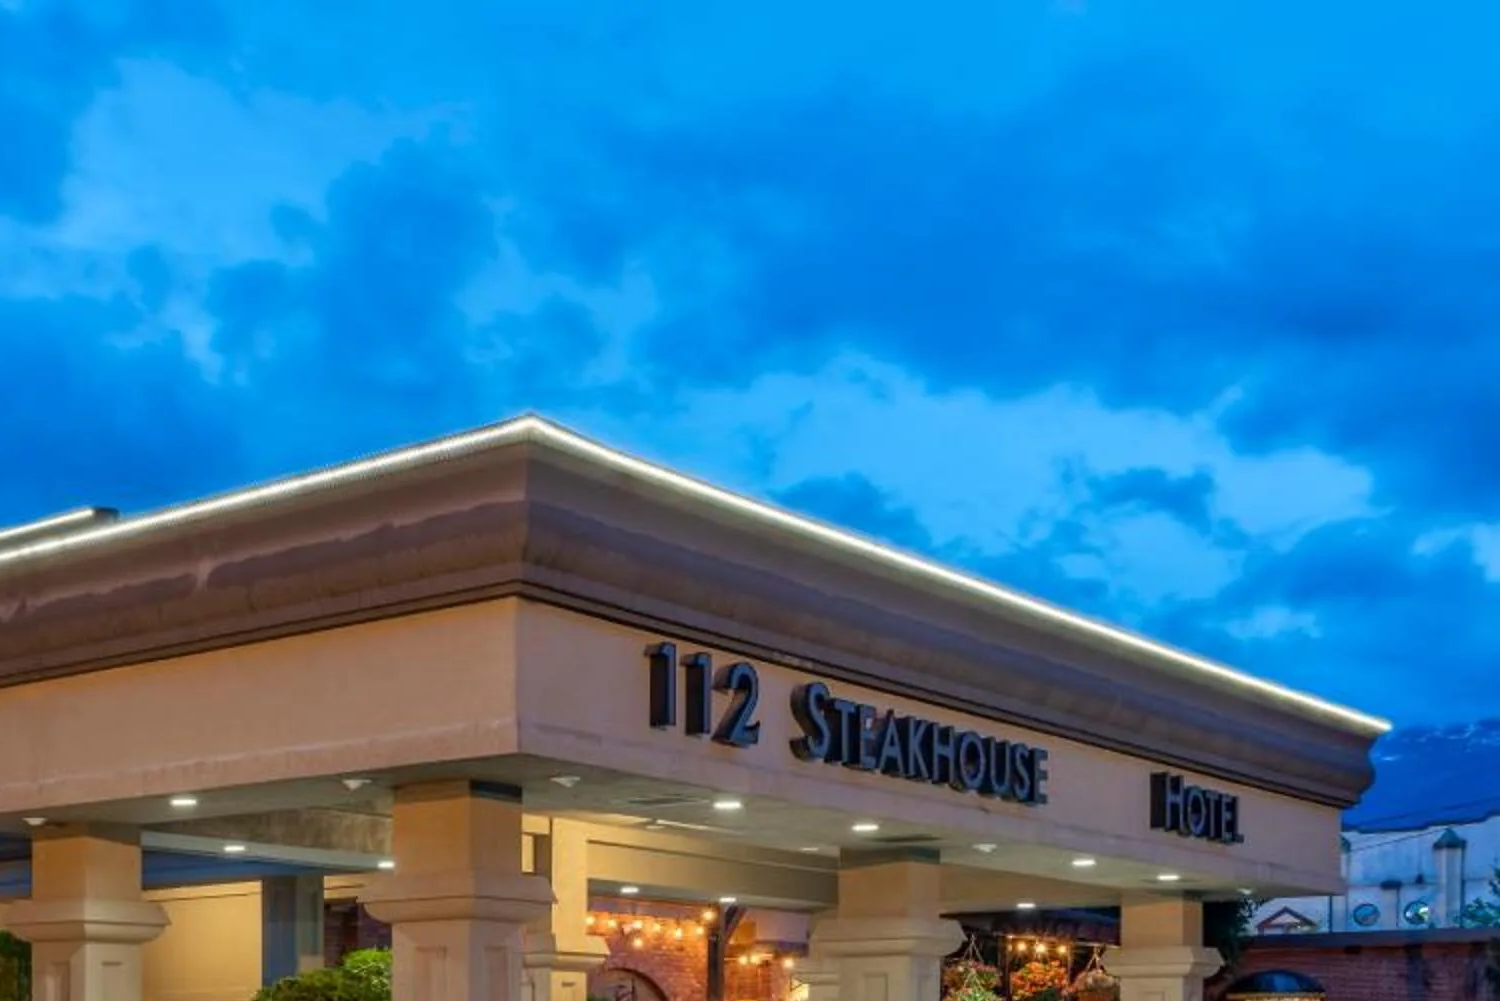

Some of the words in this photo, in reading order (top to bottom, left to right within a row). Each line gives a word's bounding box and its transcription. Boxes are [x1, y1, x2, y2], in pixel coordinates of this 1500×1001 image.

[644, 641, 761, 748] 112
[789, 681, 1049, 805] STEAKHOUSE
[1150, 772, 1245, 845] HOTEL
